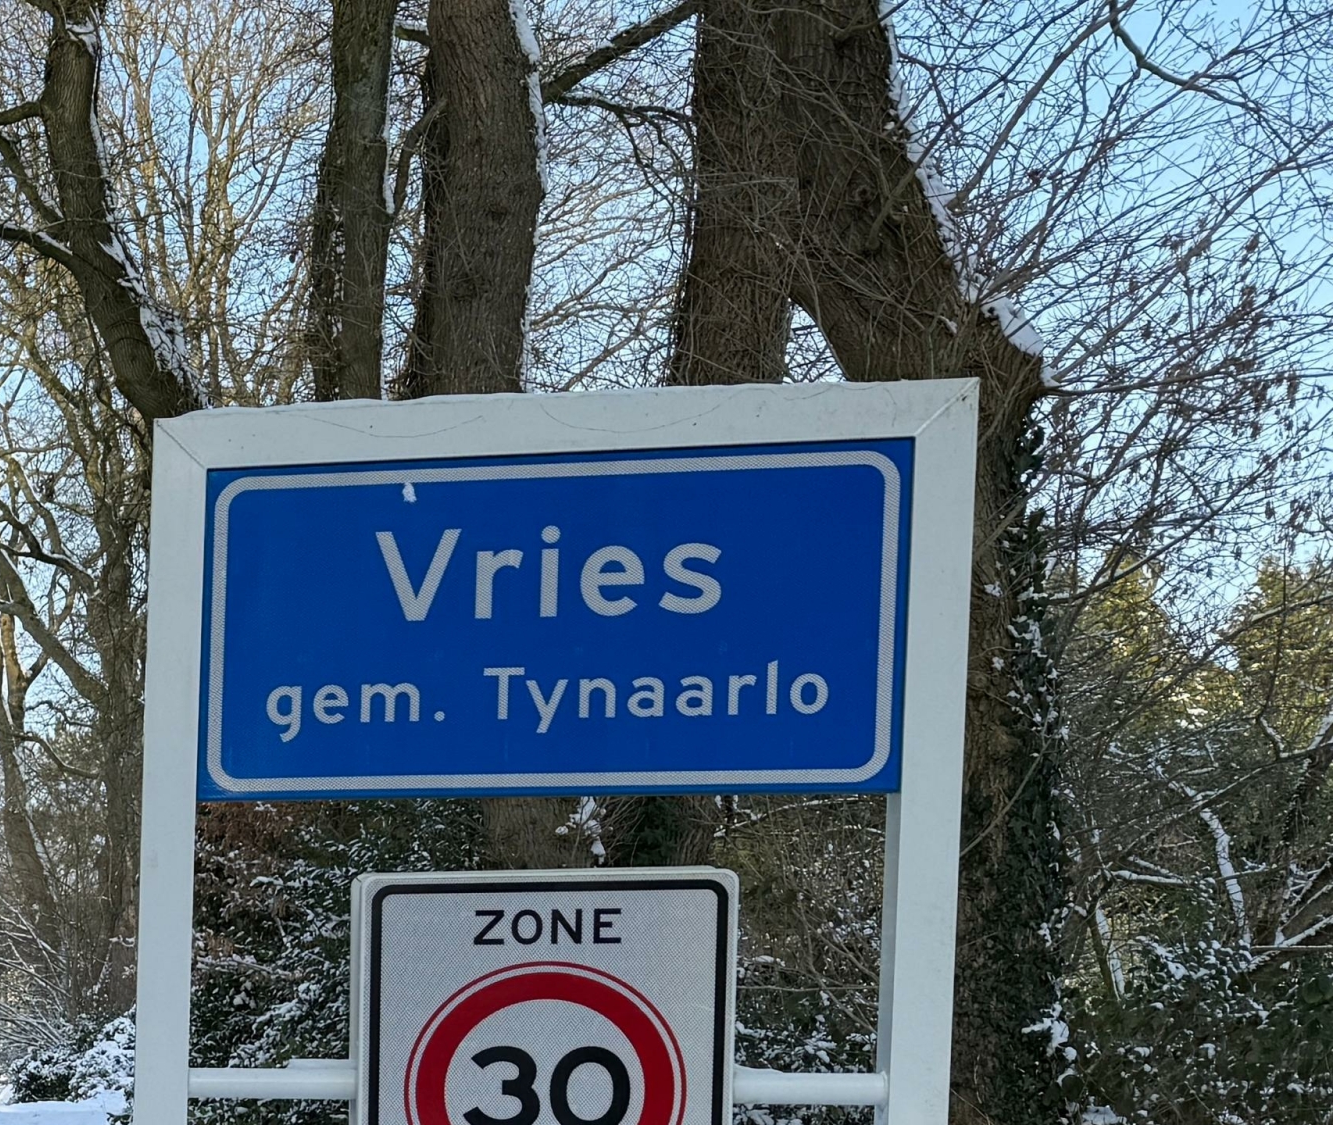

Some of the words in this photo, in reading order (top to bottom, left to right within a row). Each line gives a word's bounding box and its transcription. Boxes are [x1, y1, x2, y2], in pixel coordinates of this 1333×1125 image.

[375, 525, 724, 622] Vries
[266, 679, 446, 743] gem.
[483, 660, 830, 733] Tynaarlo
[473, 908, 622, 945] ZONE
